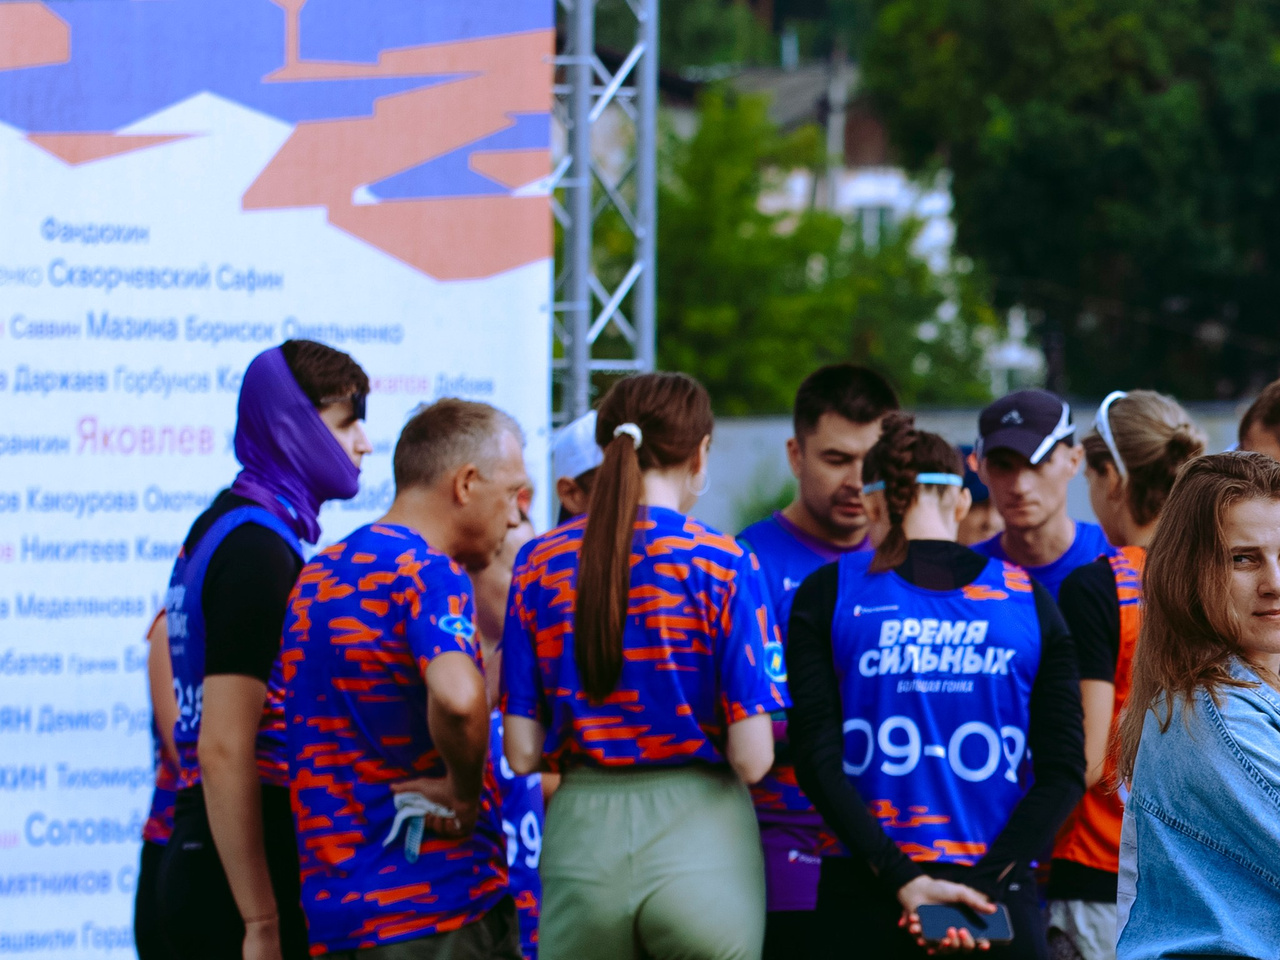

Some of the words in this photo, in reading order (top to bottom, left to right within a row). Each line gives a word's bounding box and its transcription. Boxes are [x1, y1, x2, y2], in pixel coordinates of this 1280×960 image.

[215, 263, 285, 296] Сафин
[85, 309, 179, 340] Мазина
[77, 415, 215, 456] Яковлев
[878, 617, 989, 648] ВРЕМЯ
[858, 644, 1016, 678] СИЛЬНЫХ
